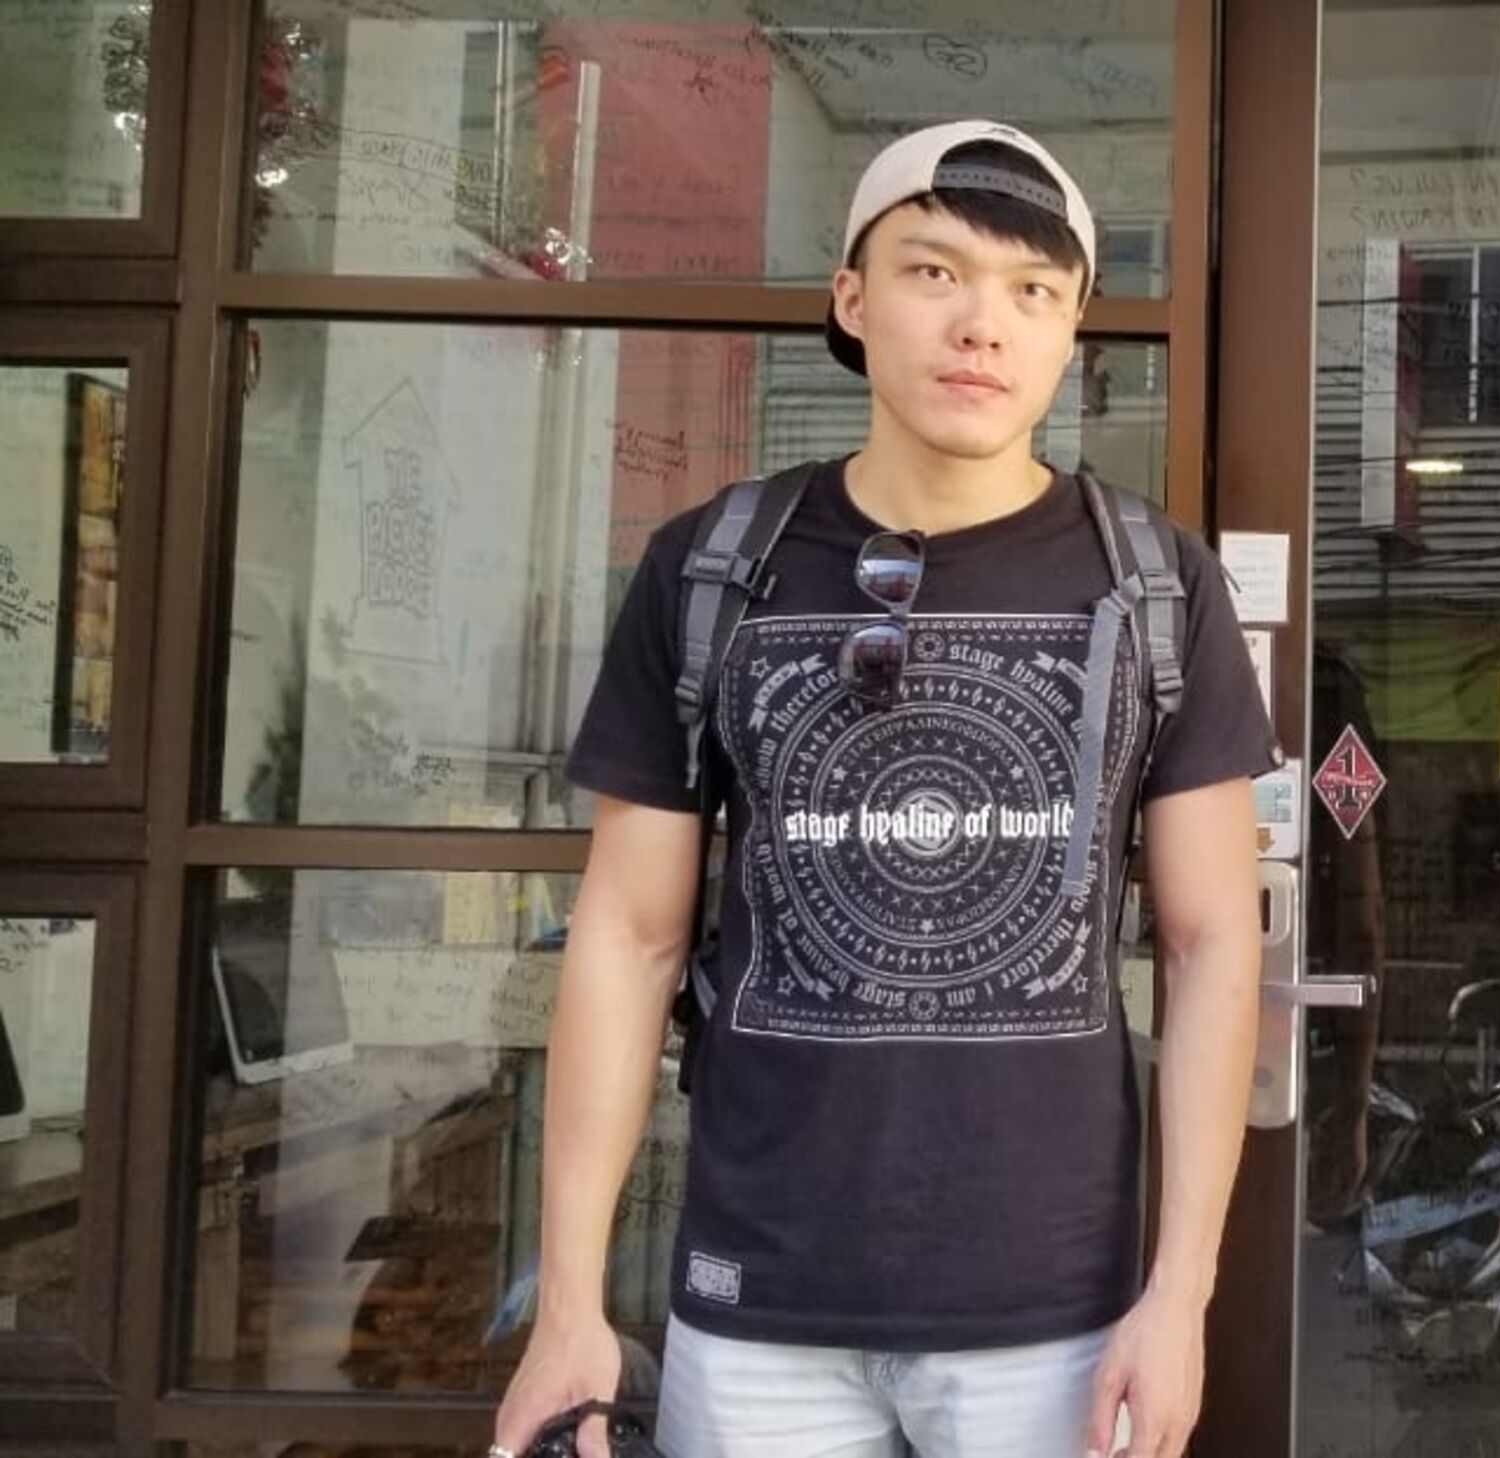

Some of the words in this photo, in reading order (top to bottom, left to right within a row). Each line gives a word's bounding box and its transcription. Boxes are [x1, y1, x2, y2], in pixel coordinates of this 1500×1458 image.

[949, 643, 1004, 671] stage
[769, 667, 839, 733] therefor
[784, 808, 850, 847] stage
[859, 803, 955, 844] hyaline
[964, 803, 992, 838] of
